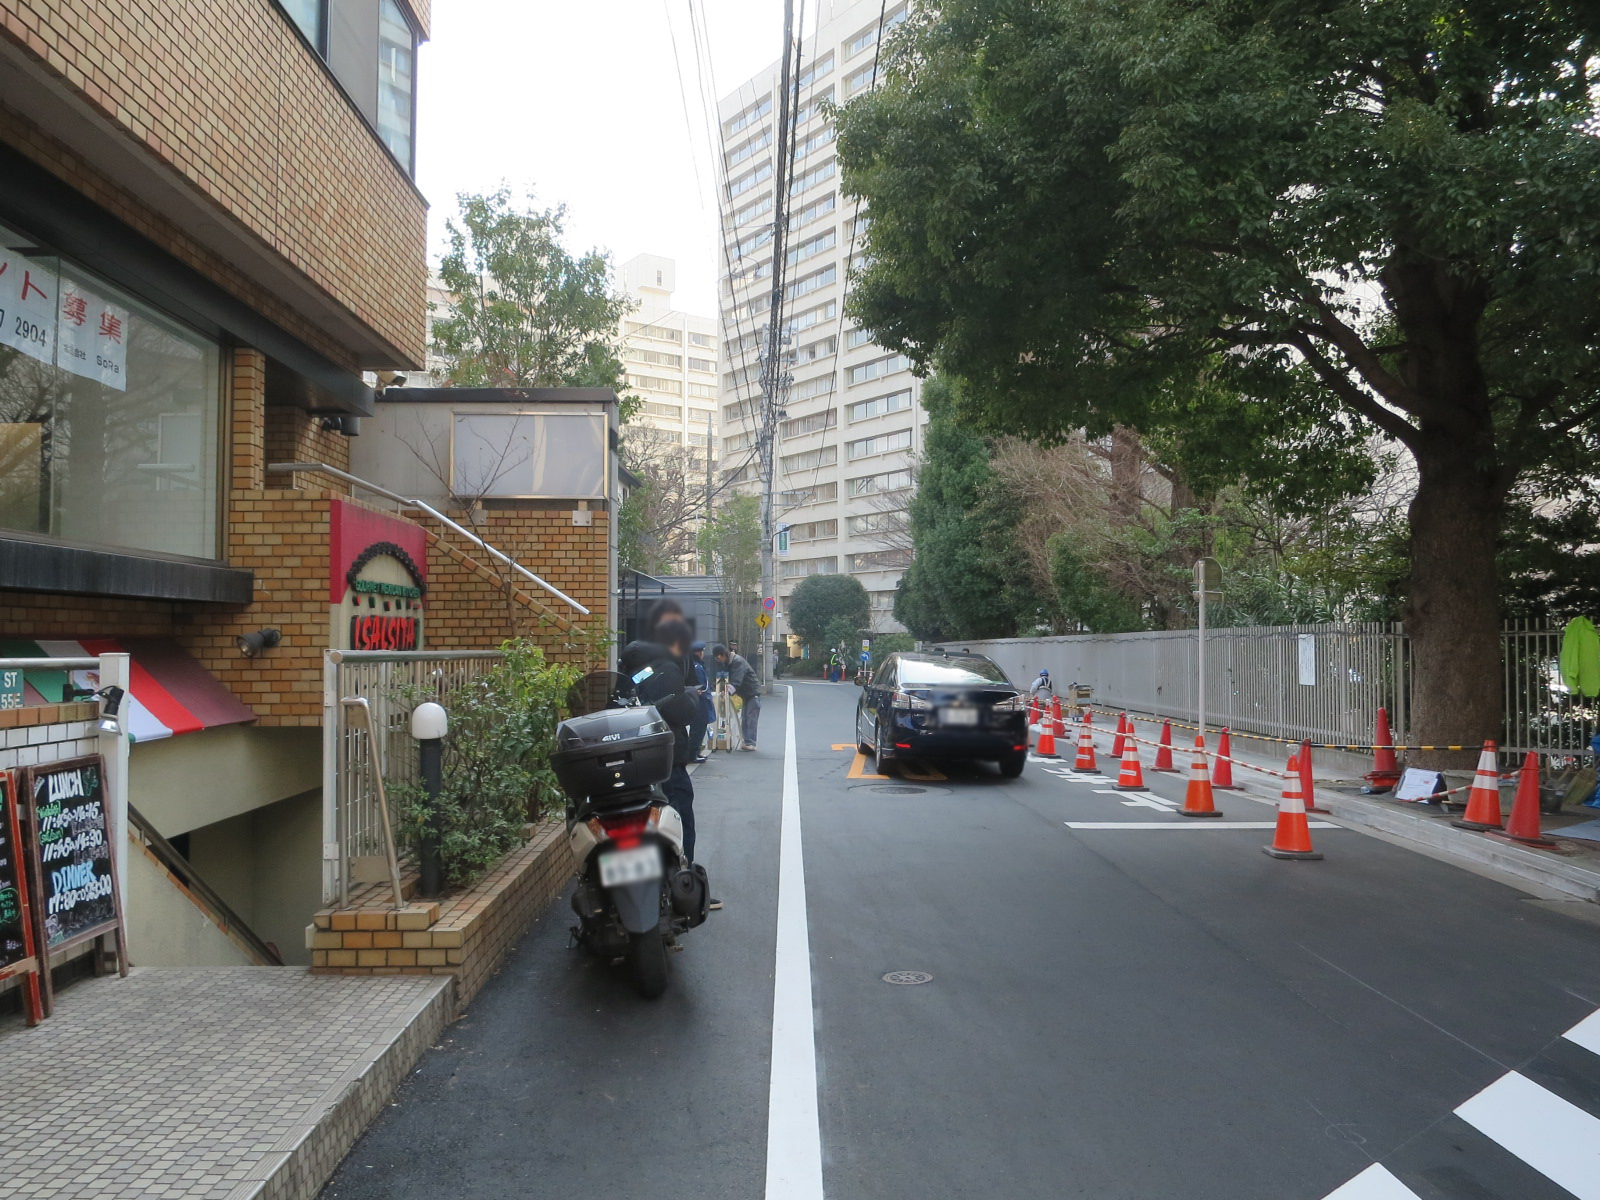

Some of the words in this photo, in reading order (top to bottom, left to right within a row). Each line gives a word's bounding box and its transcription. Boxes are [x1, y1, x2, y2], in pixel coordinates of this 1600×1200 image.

[15, 316, 47, 347] 2904
[4, 671, 18, 688] ST
[602, 733, 621, 742] GIVI
[48, 769, 84, 803] LUNCH
[52, 861, 97, 895] DINNER
